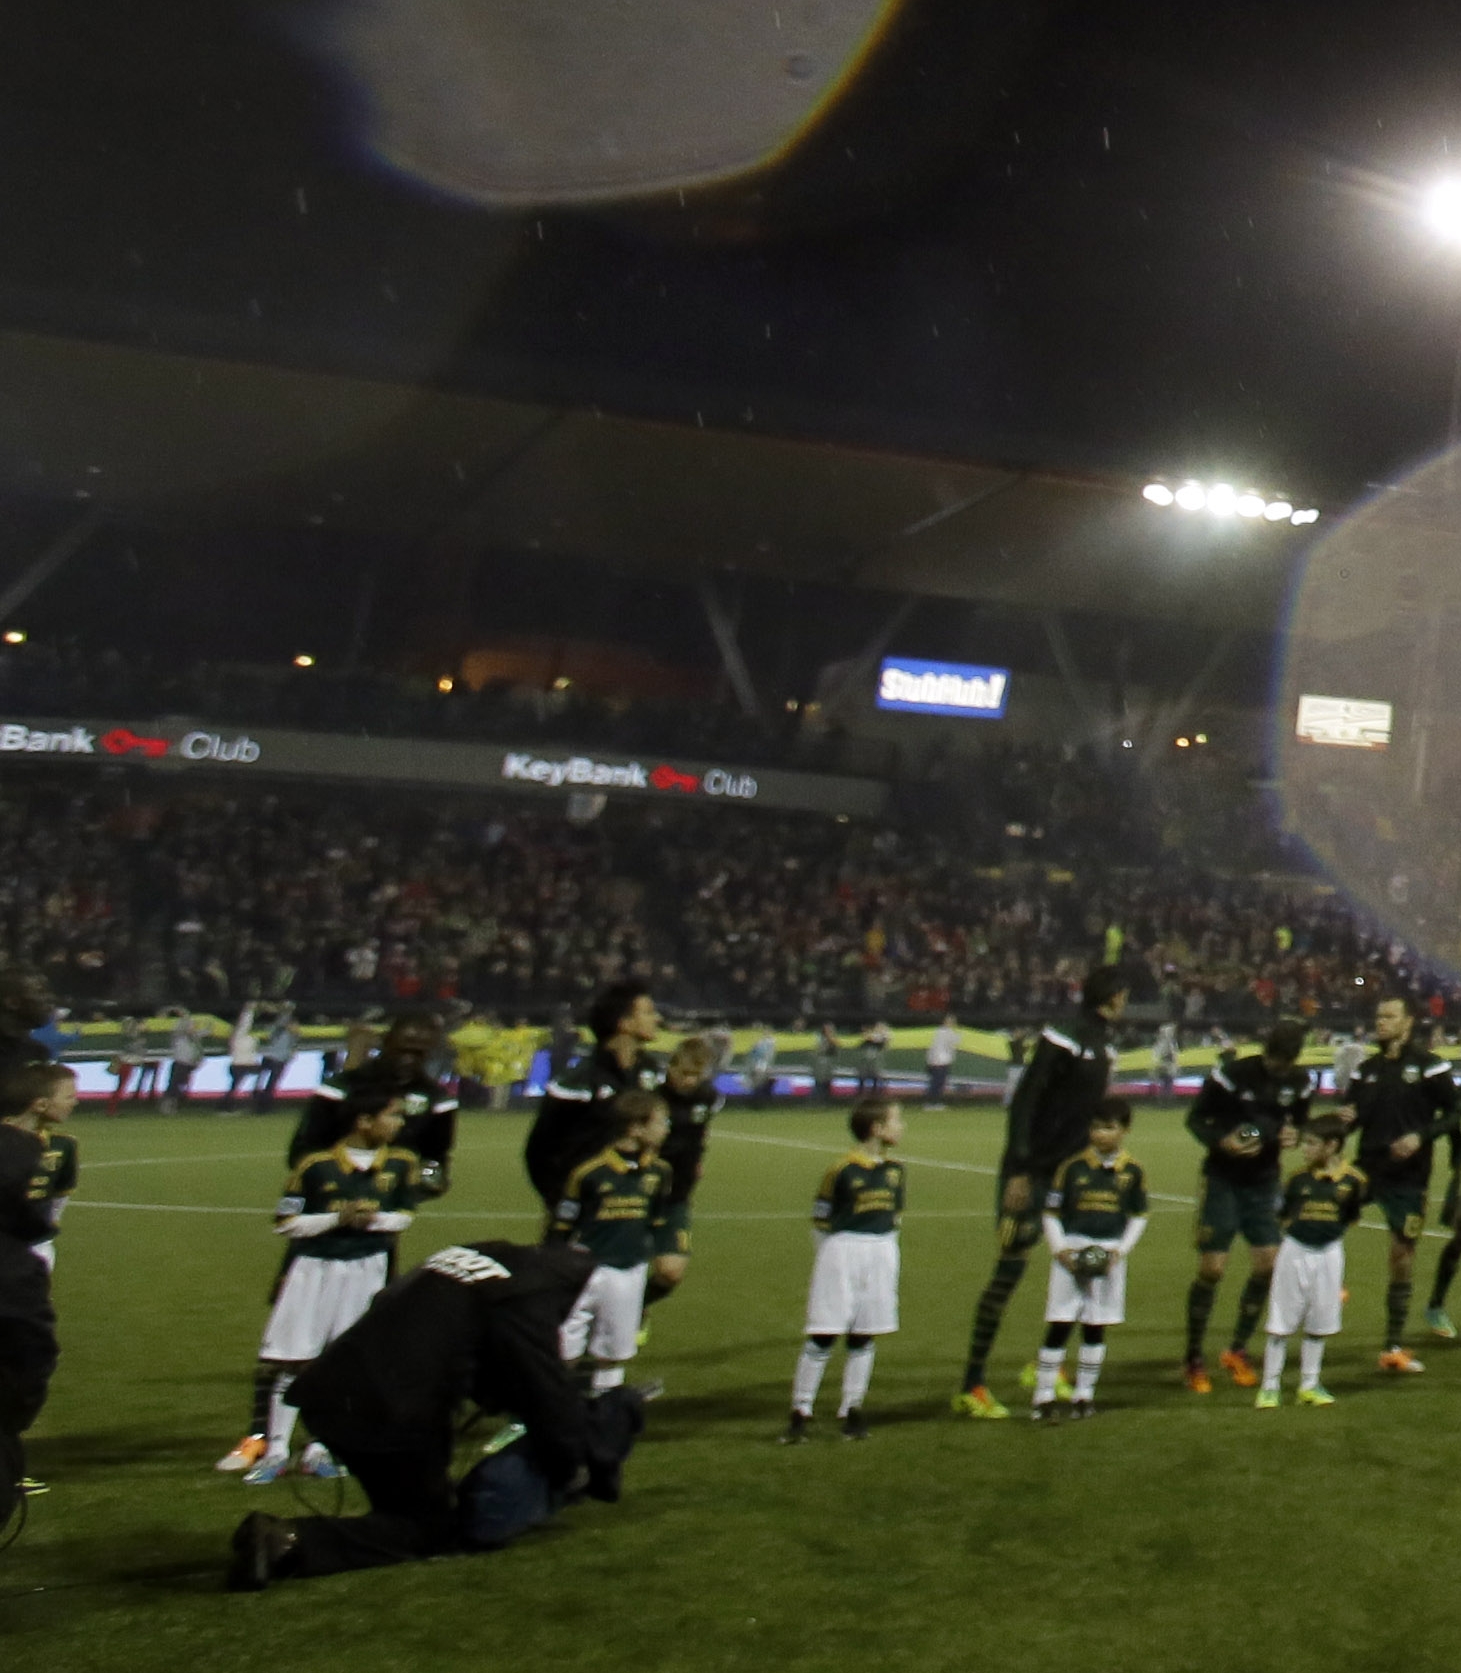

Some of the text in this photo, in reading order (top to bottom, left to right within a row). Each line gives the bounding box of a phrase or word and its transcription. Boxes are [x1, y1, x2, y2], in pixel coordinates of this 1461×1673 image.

[0, 723, 262, 764] Bank Club
[502, 752, 758, 799] KeyBank Club
